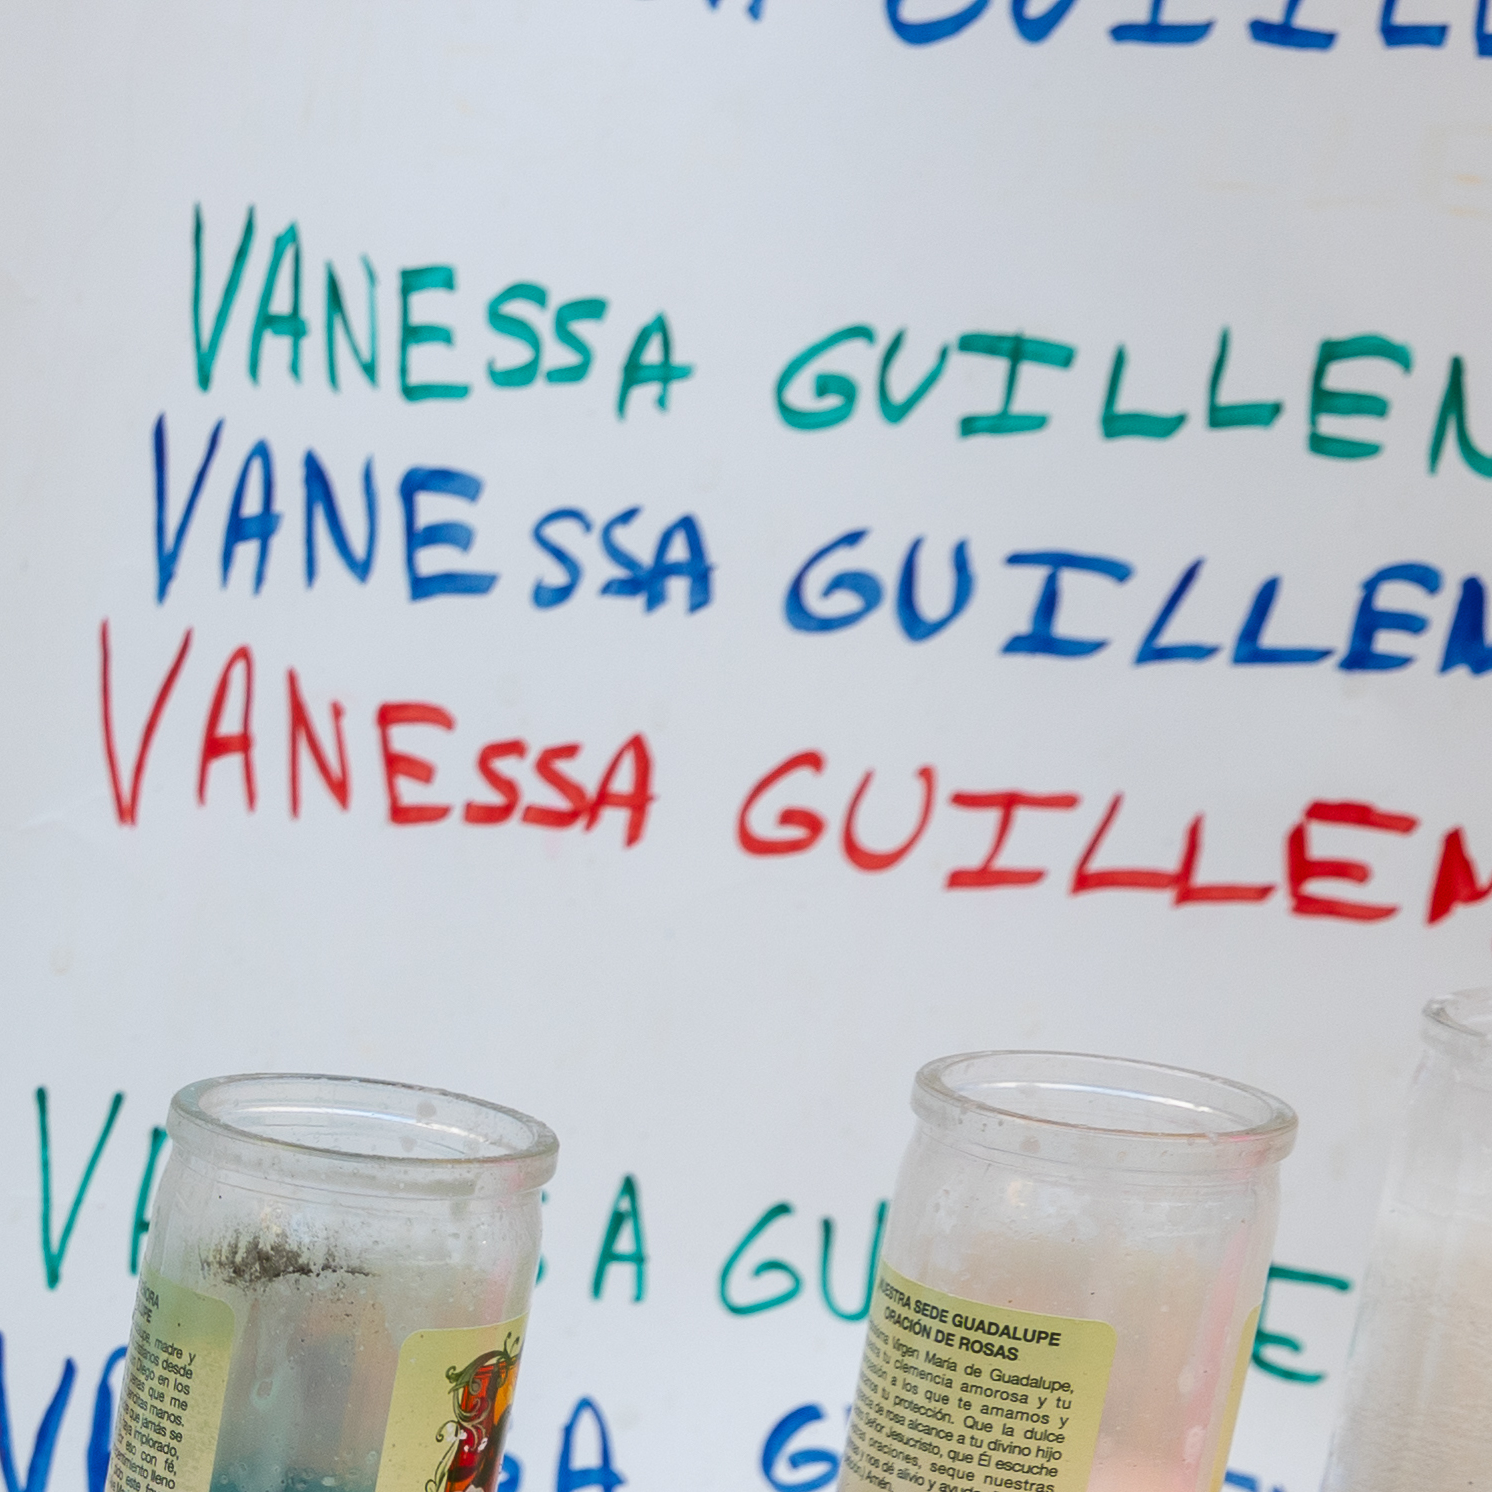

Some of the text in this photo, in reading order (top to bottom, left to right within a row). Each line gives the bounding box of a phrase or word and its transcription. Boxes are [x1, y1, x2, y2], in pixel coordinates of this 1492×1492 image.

[190, 202, 696, 422] VANESSA
[152, 412, 717, 614] VANESSA
[100, 620, 656, 849] VANESSA
[884, 1306, 1019, 1361] ORACIÓN DE ROSAS
[913, 1299, 949, 1324] SEDE
[951, 1313, 1062, 1347] GUADALUPE
[161, 1357, 193, 1380] desde
[173, 1377, 190, 1396] los
[924, 1350, 958, 1372] María
[963, 1363, 983, 1378] de
[989, 1367, 1074, 1394] Guadalupe,
[924, 1389, 950, 1405] que
[957, 1396, 972, 1411] te
[979, 1404, 1050, 1425] amamos
[959, 1382, 1029, 1404] amorosa
[1036, 1396, 1048, 1410] y
[1055, 1396, 1072, 1410] tu
[168, 1429, 183, 1443] se
[907, 1418, 954, 1442] alcance
[956, 1434, 966, 1445] a
[969, 1434, 984, 1449] tu
[985, 1438, 1032, 1457] divino
[1034, 1445, 1062, 1463] hijo
[963, 1415, 993, 1433] Que
[1001, 1422, 1015, 1437] la
[1023, 1427, 1065, 1444] dulce
[929, 1462, 975, 1482] seque
[947, 1449, 974, 1464] que
[994, 1459, 1058, 1478] escuche
